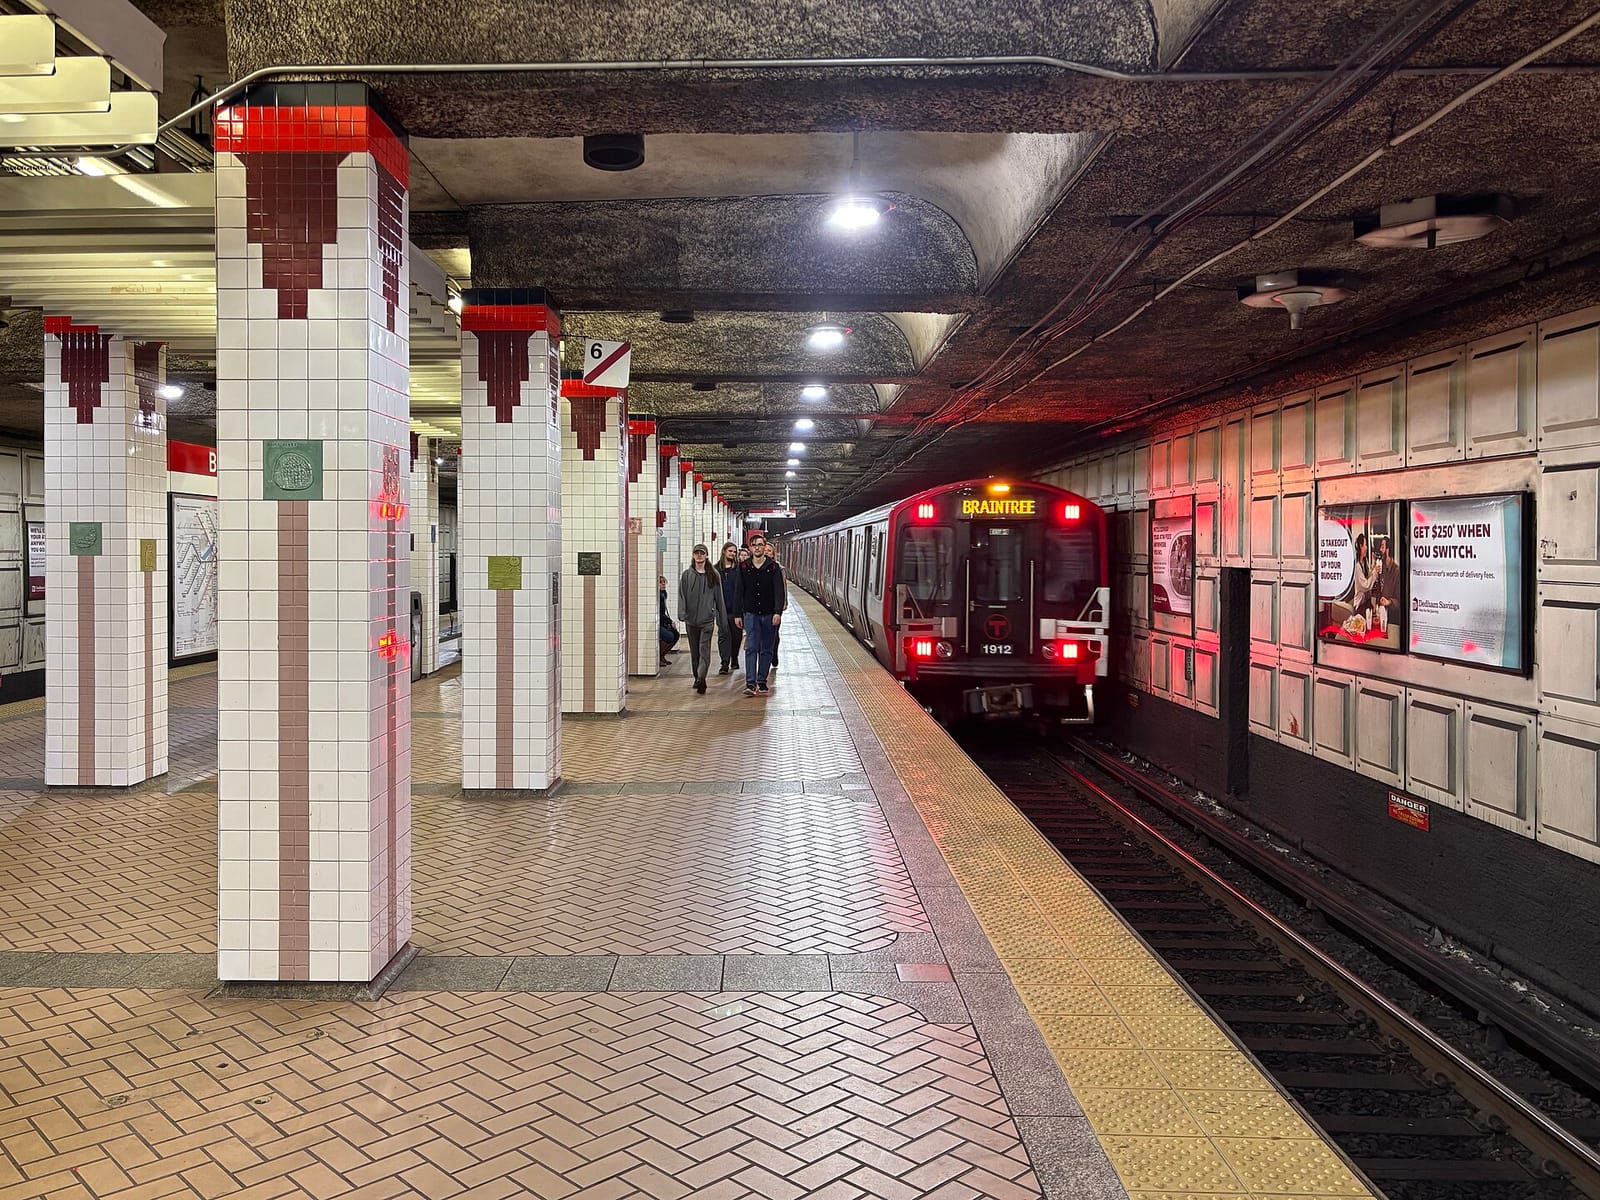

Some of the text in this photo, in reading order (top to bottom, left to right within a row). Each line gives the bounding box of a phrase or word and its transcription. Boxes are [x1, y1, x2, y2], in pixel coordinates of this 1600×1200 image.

[591, 343, 602, 359] 6
[962, 500, 1036, 514] BRAINTREE
[1413, 526, 1430, 539] GET
[1457, 524, 1491, 538] WHEN
[1321, 539, 1348, 547] IS TAKEOUT
[1321, 550, 1338, 558] EATING
[1413, 545, 1477, 559] YOU SWITCH.
[1321, 561, 1341, 569] UP YOUR
[1321, 572, 1342, 580] BUDGET?
[1460, 570, 1465, 578] of
[1465, 571, 1483, 580] delivery
[1483, 571, 1495, 579] fees.
[983, 644, 1012, 654] 1912
[1391, 795, 1426, 812] DANGER
